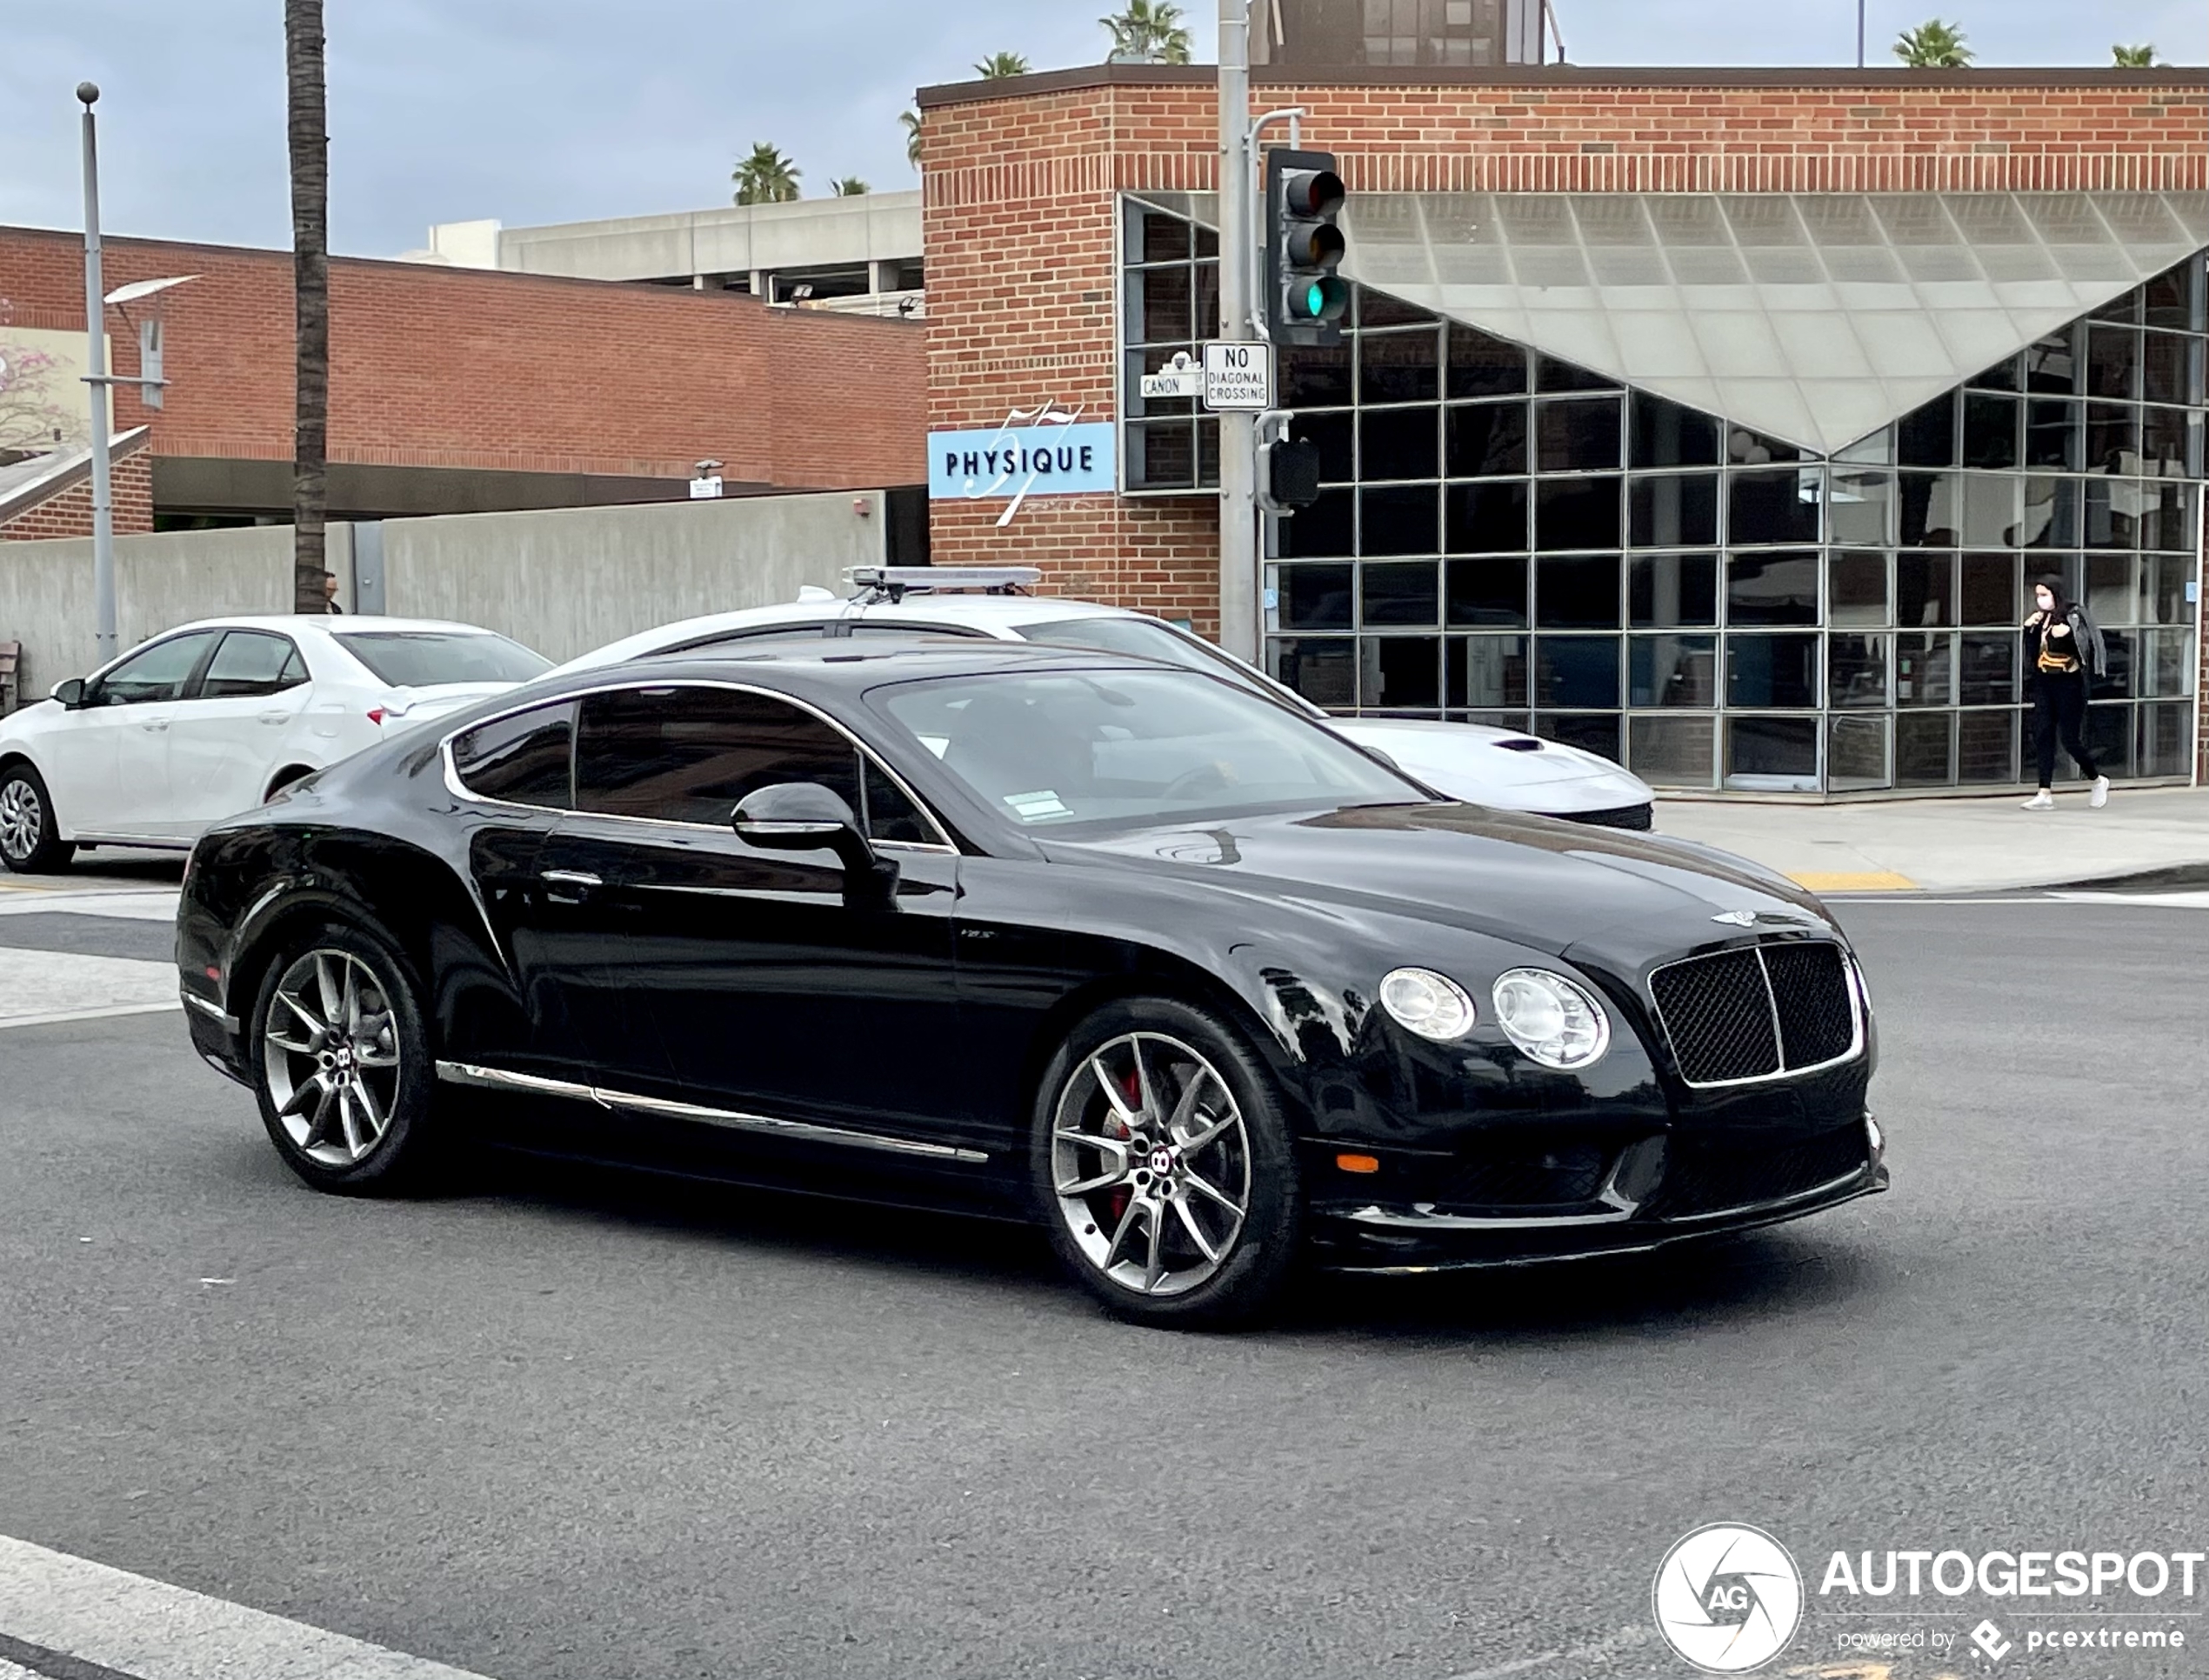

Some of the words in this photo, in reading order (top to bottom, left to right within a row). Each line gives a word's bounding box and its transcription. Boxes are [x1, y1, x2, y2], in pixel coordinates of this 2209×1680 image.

[1225, 348, 1249, 368] NO
[1144, 377, 1180, 395] CANON
[1209, 372, 1265, 384] DIAGONAL
[1209, 388, 1266, 400] CROSSING
[945, 446, 1093, 477] PHYSIQUE
